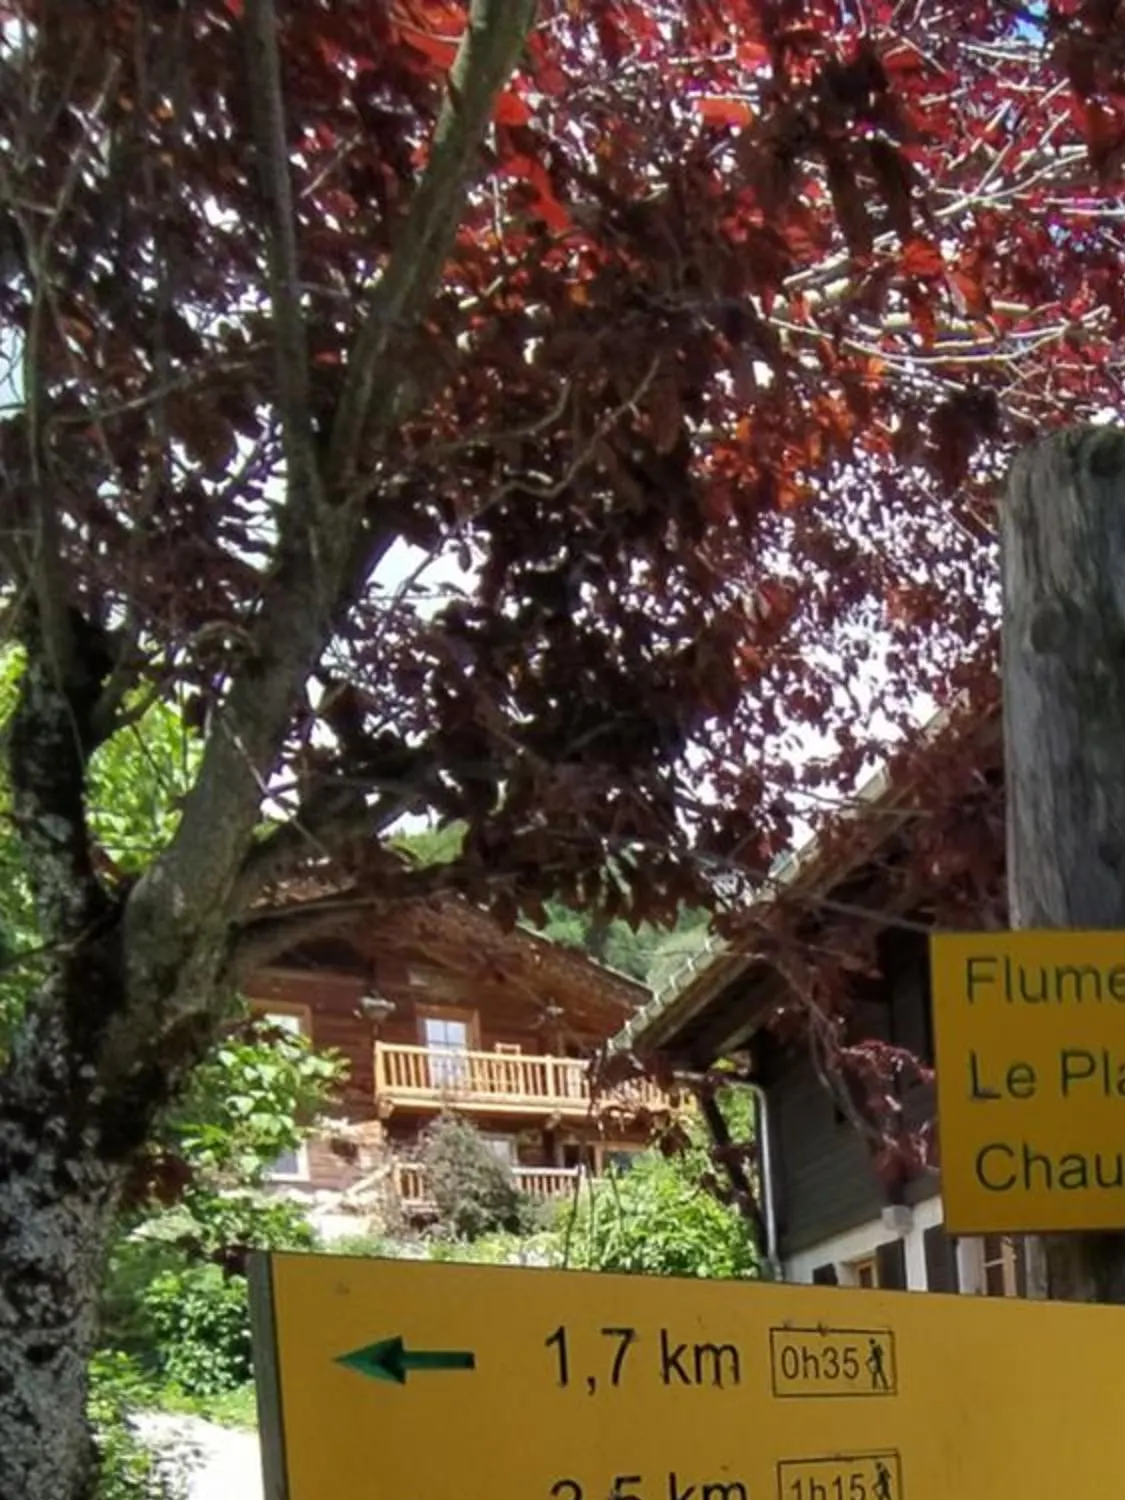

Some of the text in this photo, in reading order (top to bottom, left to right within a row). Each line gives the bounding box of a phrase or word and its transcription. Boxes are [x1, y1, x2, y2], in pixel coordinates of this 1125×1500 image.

[970, 1049, 1036, 1100] Le
[545, 1326, 741, 1396] 1,7 km
[780, 1346, 861, 1380] 0h35
